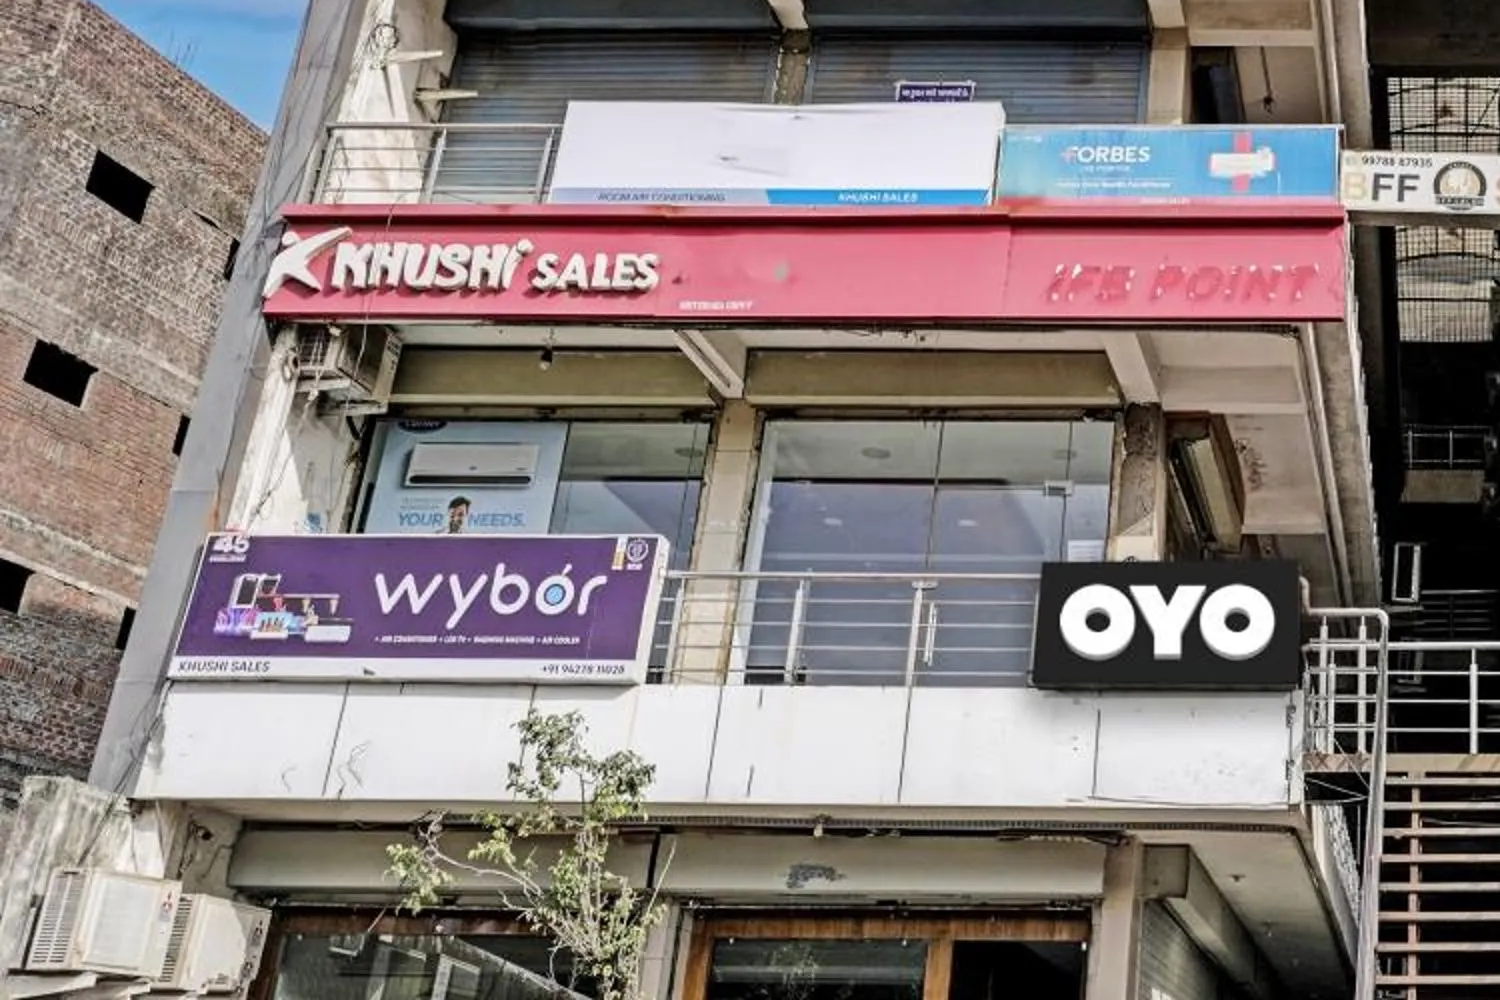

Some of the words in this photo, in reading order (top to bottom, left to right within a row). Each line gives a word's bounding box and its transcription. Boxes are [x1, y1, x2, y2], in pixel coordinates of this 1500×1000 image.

[1343, 171, 1421, 203] BFF
[532, 252, 660, 291] SALES
[1151, 263, 1320, 302] POINT
[399, 512, 445, 527] YOUR
[467, 512, 526, 528] NEEDS.
[374, 563, 608, 630] wybór
[1059, 583, 1276, 661] OYO
[177, 659, 229, 674] KHUSHI
[230, 660, 271, 674] SALES
